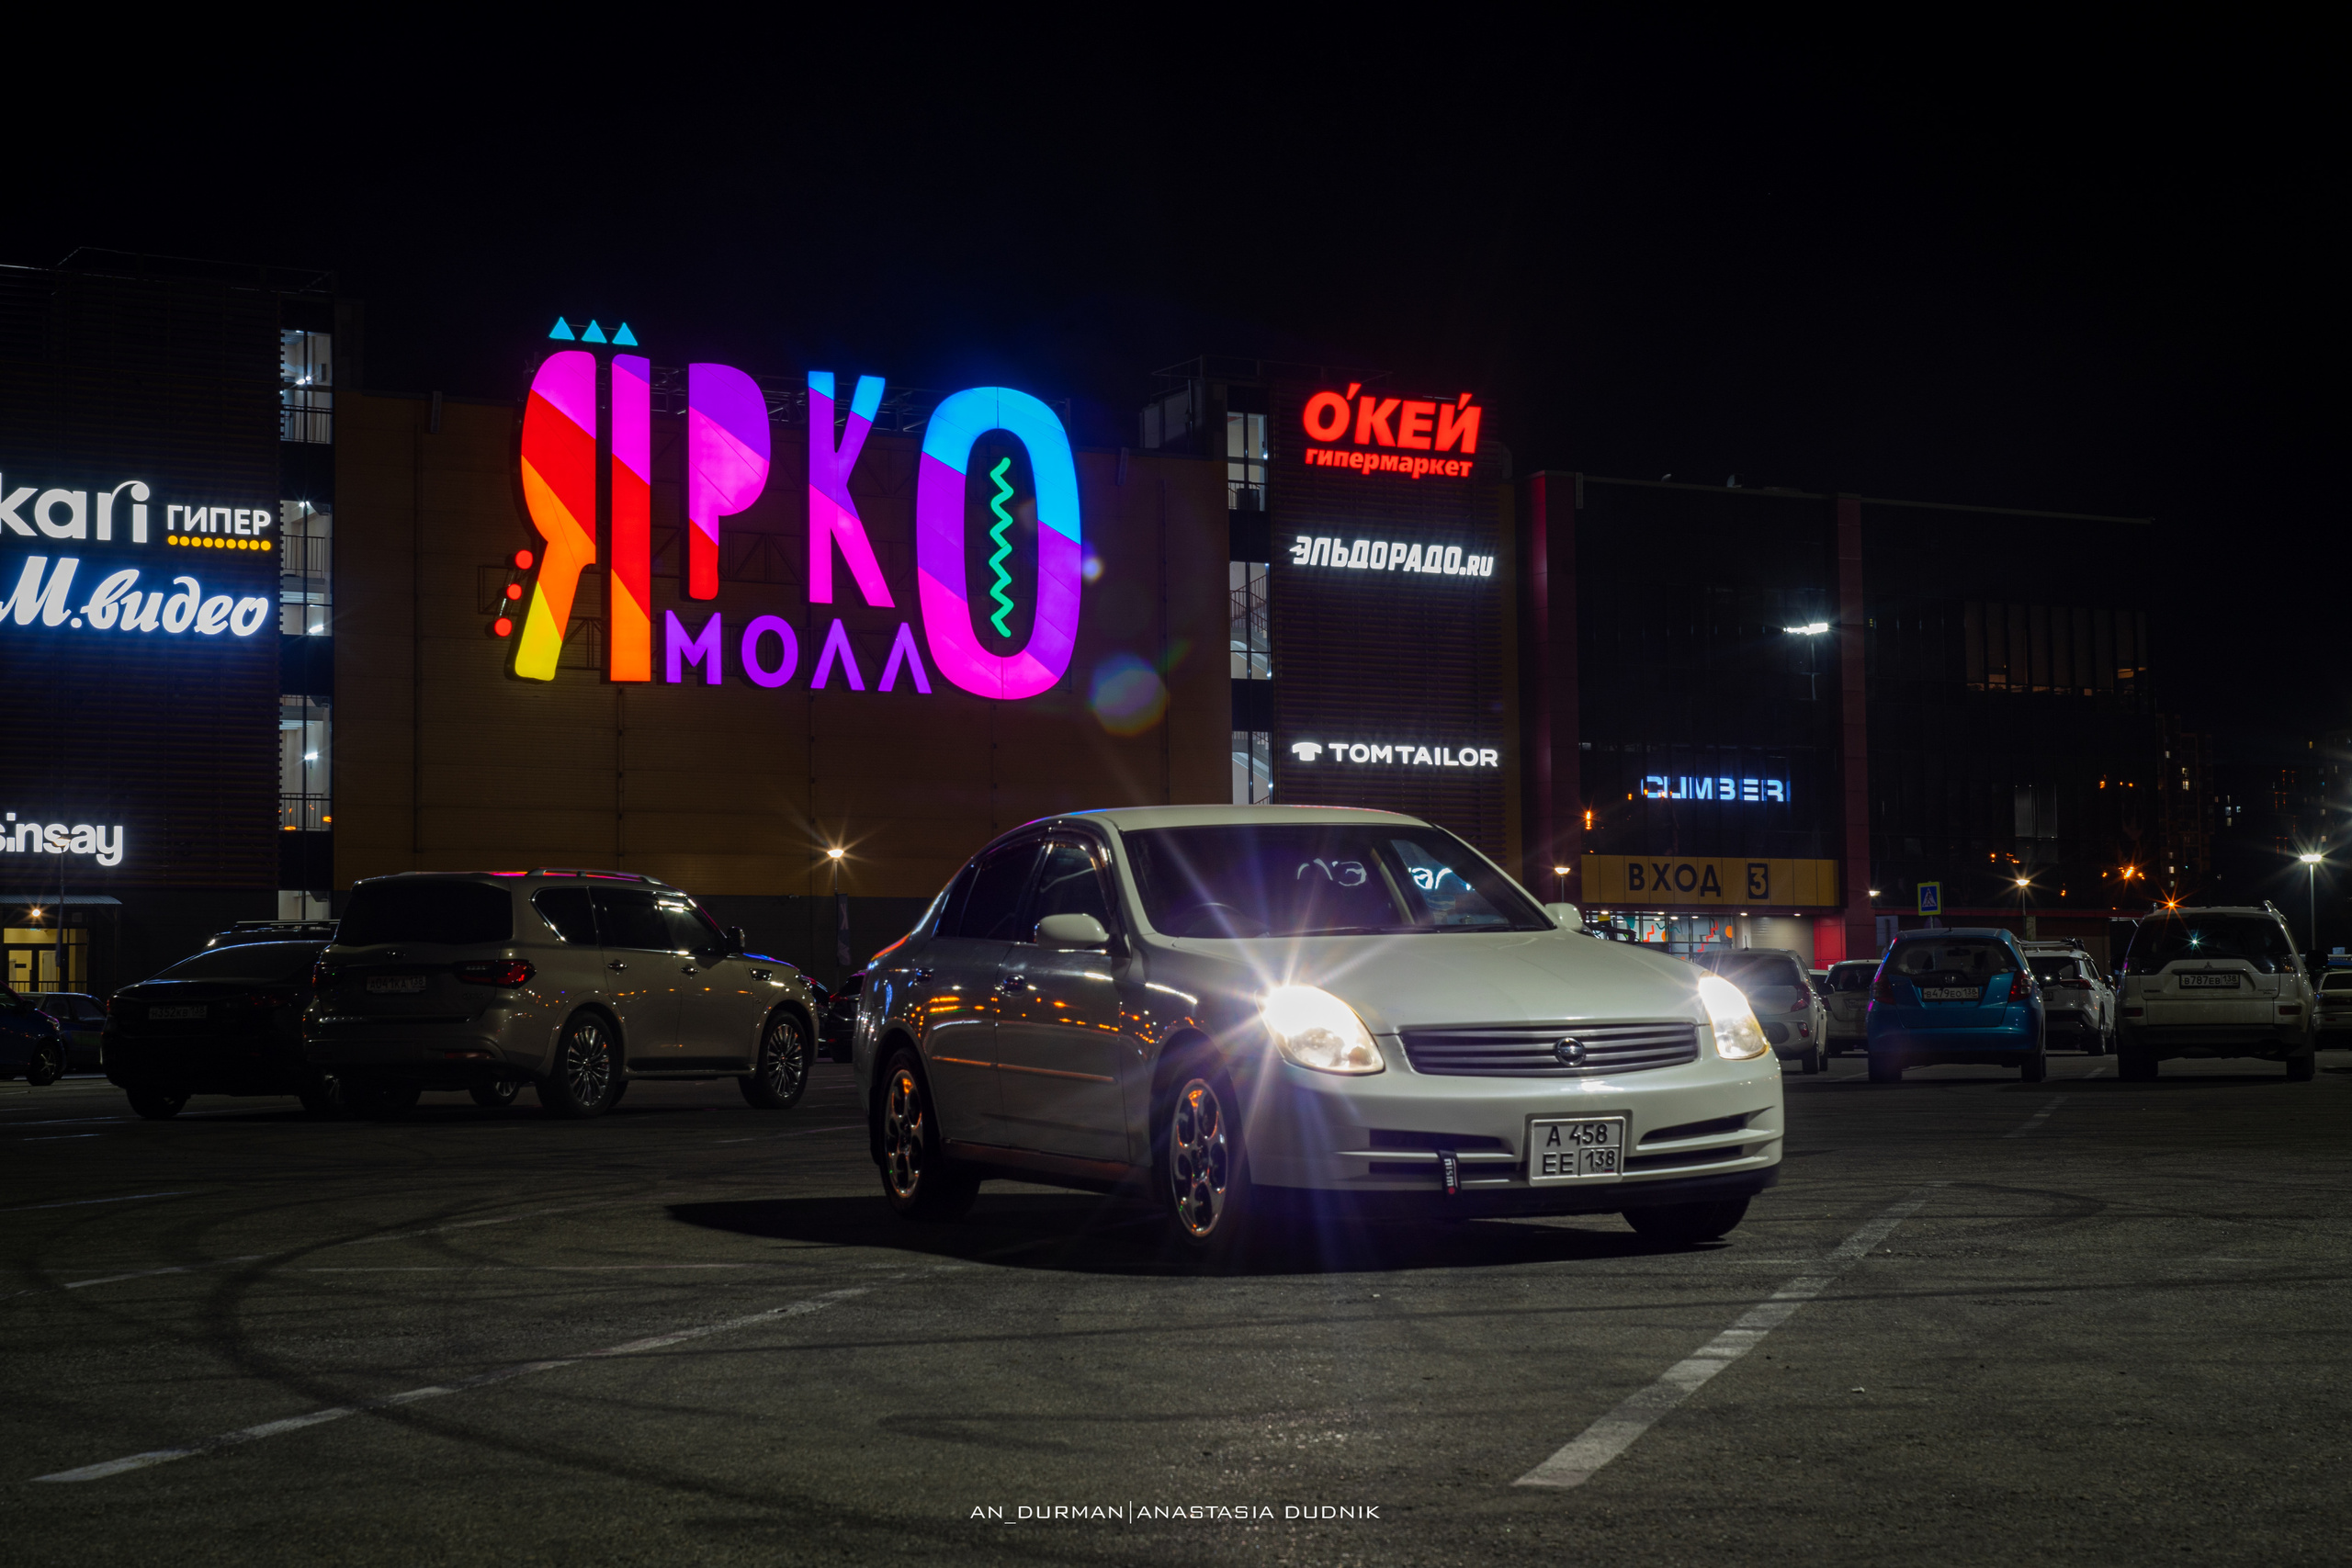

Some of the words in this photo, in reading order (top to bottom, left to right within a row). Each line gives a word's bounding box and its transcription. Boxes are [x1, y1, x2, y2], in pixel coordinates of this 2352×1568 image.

[1305, 448, 1474, 479] гипермаркет
[0, 473, 151, 544] kari
[167, 504, 272, 536] ГИПЕР
[514, 350, 1081, 700] ЯРКО
[0, 555, 269, 637] М.видео
[1640, 775, 1786, 803] CLIMBER
[0, 812, 124, 867] insay
[1628, 863, 1722, 897] ВХОД
[1749, 865, 1767, 897] 3
[1585, 1149, 1615, 1168] 138
